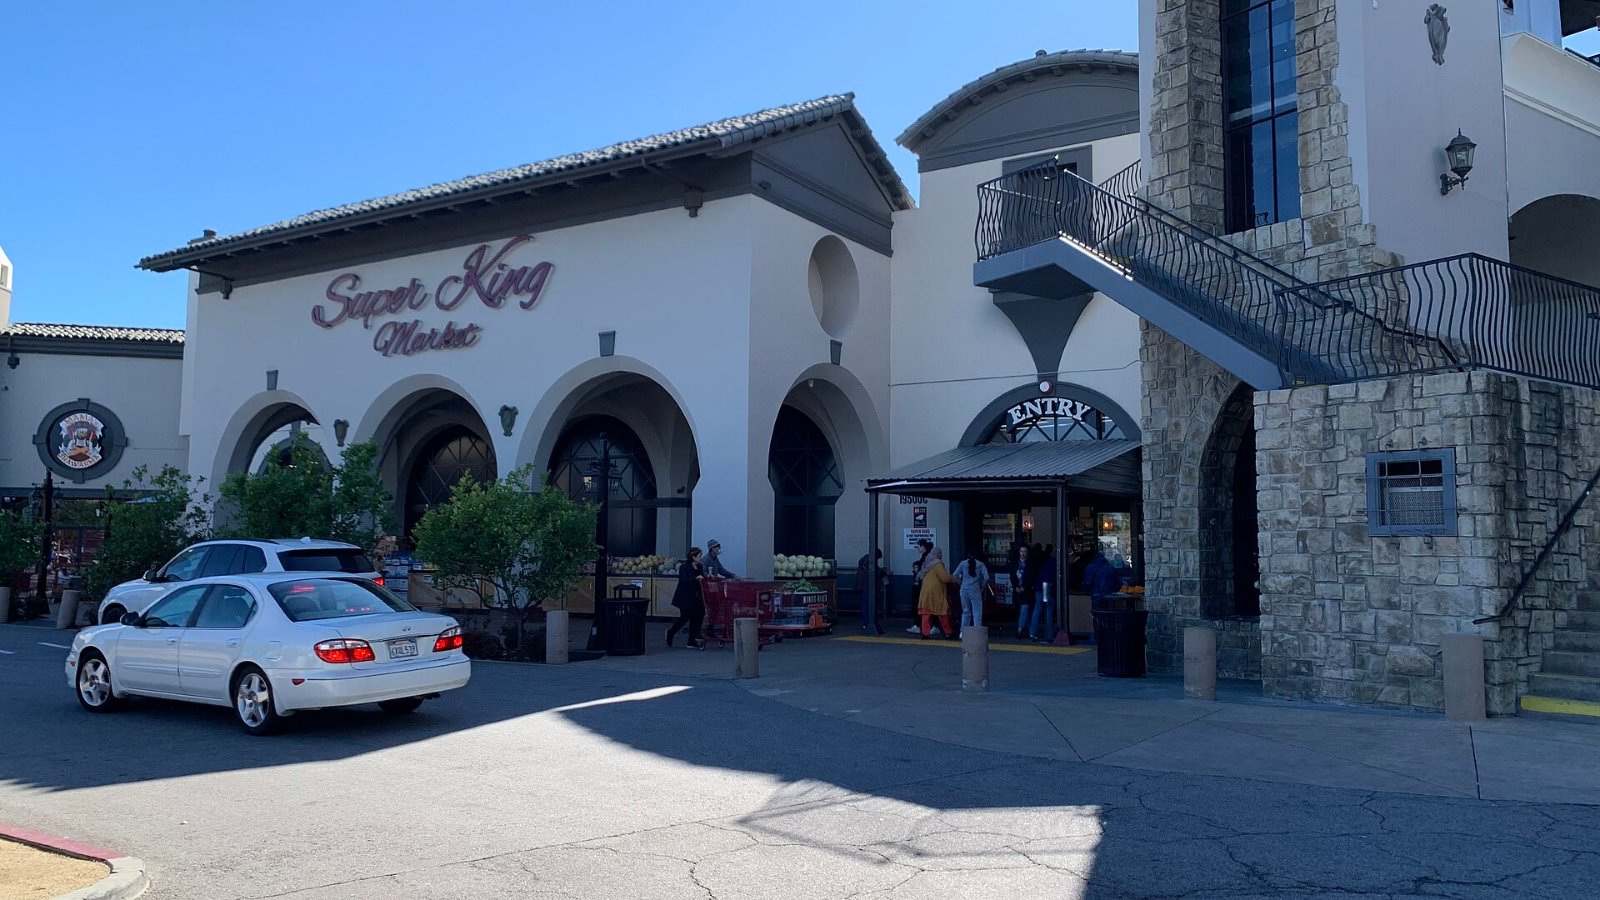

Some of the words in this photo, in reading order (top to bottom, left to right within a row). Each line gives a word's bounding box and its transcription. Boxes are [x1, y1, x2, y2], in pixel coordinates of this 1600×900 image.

[311, 273, 431, 329] Super
[435, 234, 554, 310] King
[373, 319, 484, 357] Market
[1007, 397, 1091, 424] ENTRY
